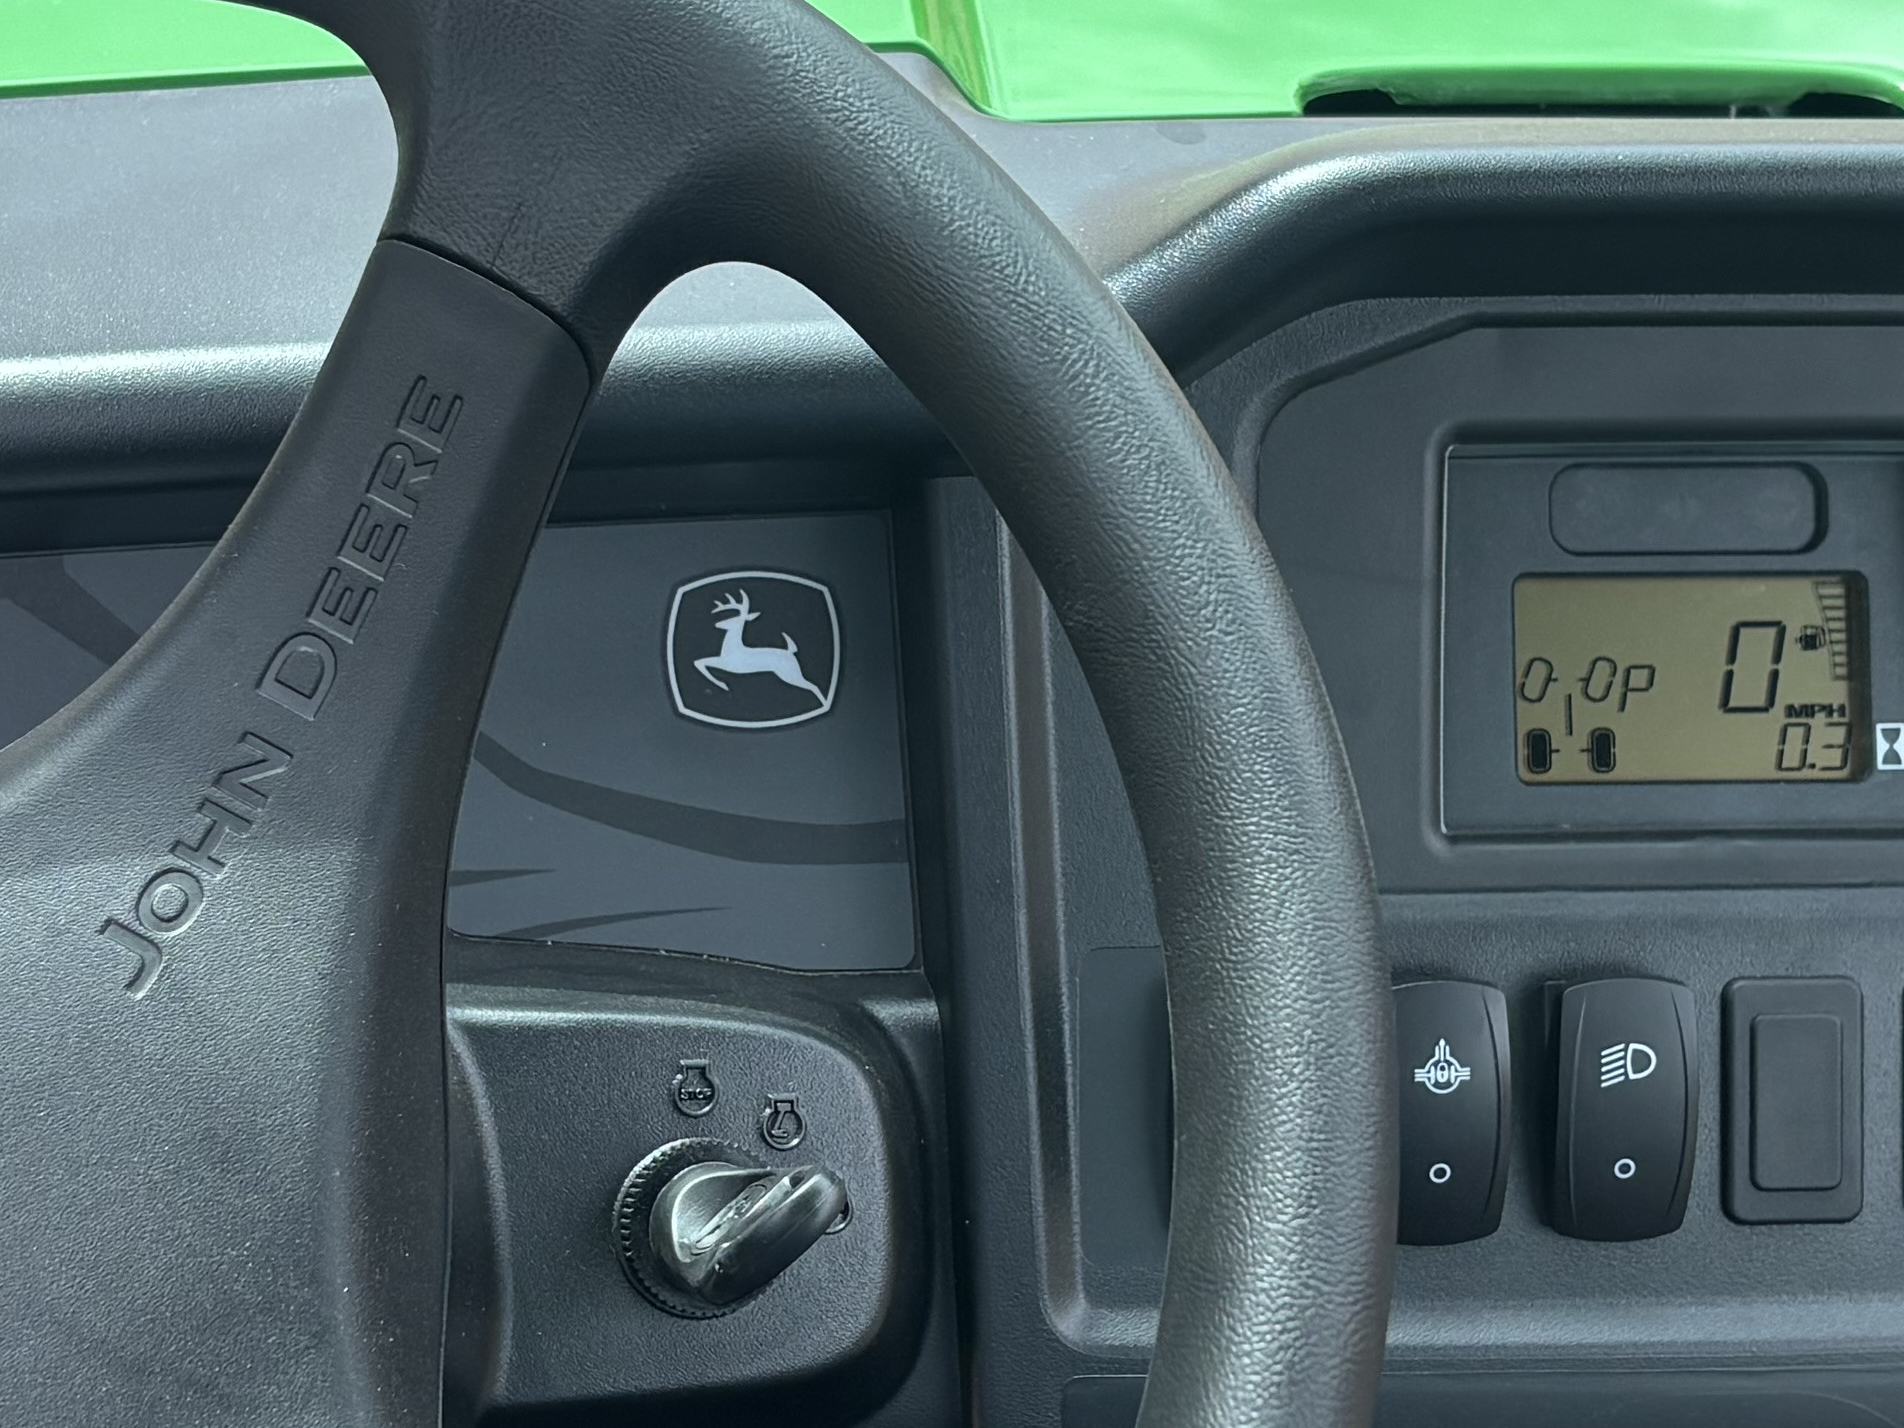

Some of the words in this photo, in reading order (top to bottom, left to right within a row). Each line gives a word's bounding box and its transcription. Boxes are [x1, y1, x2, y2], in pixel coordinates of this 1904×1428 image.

[97, 728, 296, 1001] JOHN
[257, 373, 467, 723] DEERE
[1785, 703, 1847, 720] MPH
[1776, 722, 1852, 772] 0.3
